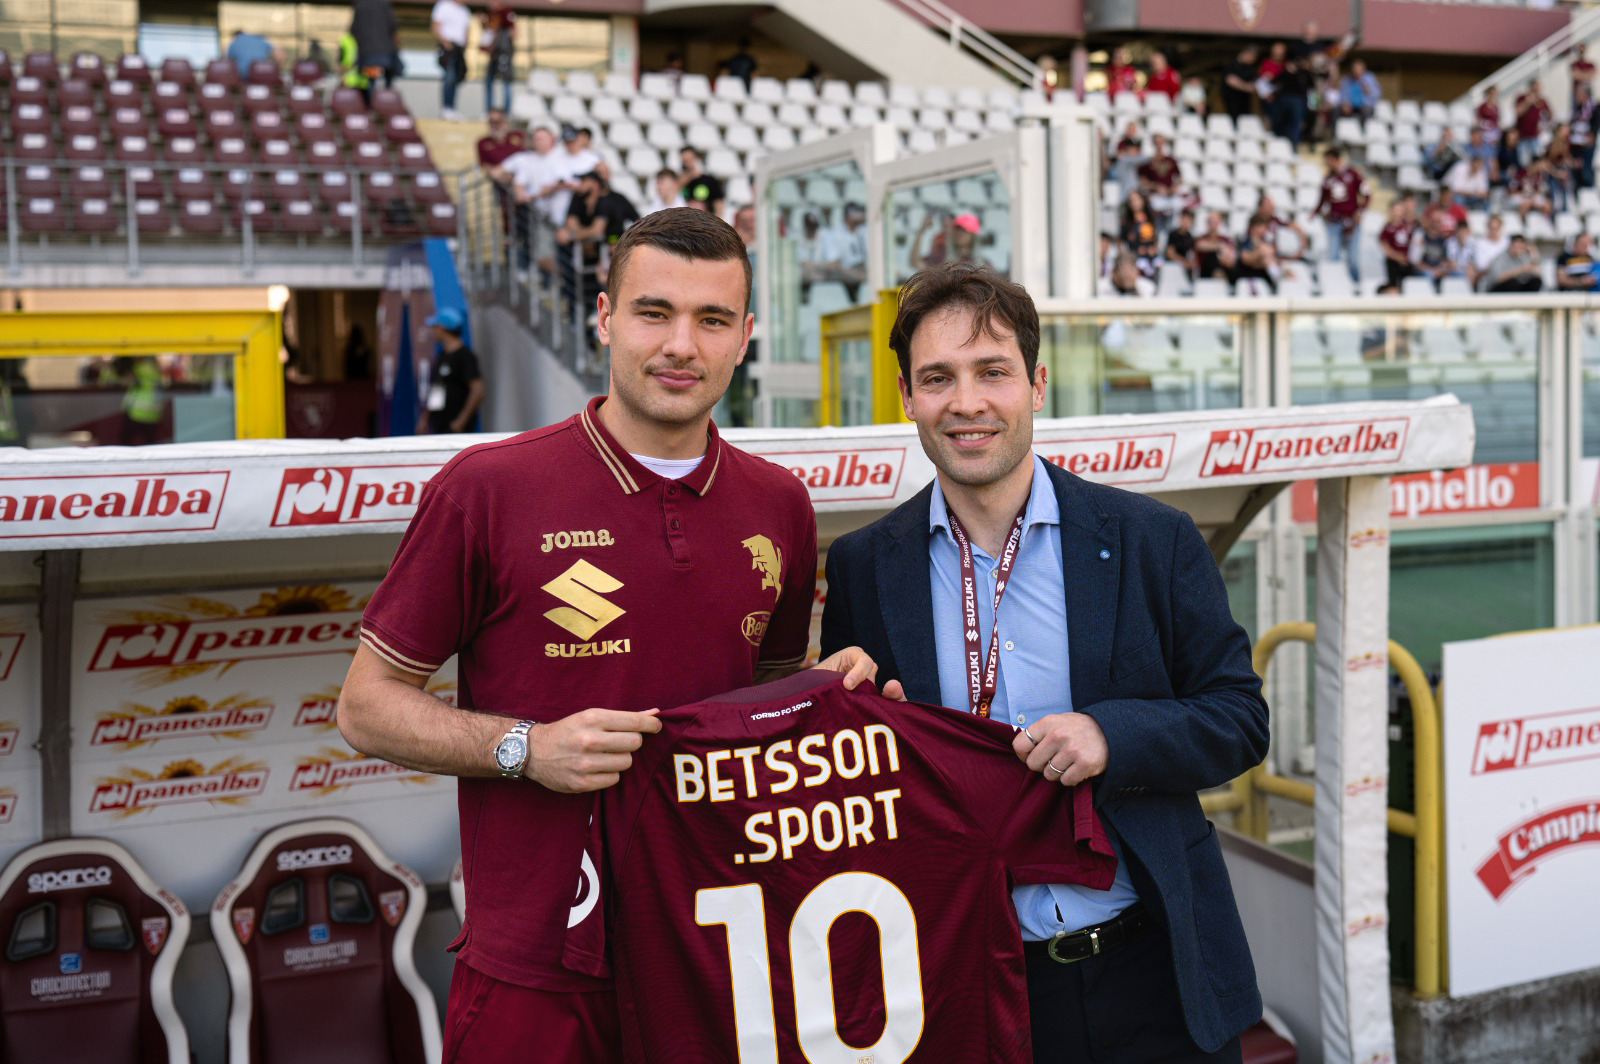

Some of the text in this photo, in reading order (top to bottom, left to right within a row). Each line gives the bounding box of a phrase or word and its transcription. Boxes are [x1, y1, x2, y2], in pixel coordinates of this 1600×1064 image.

[1251, 425, 1399, 471] panealba
[1001, 527, 1021, 572] SUZUKI
[965, 577, 976, 627] SUZUKI
[544, 638, 631, 658] SUZUKI
[985, 637, 998, 688] SUZUKI
[969, 651, 981, 703] SUZUKI
[135, 709, 265, 739] panealba
[750, 700, 813, 721] TORINO FC 1906
[673, 724, 900, 803] BETSSON
[133, 773, 260, 807] panealba
[733, 789, 902, 864] .SPORT
[1508, 804, 1600, 861] Campi
[27, 866, 113, 892] sparco
[277, 845, 353, 870] sparco
[695, 871, 925, 1064] 10
